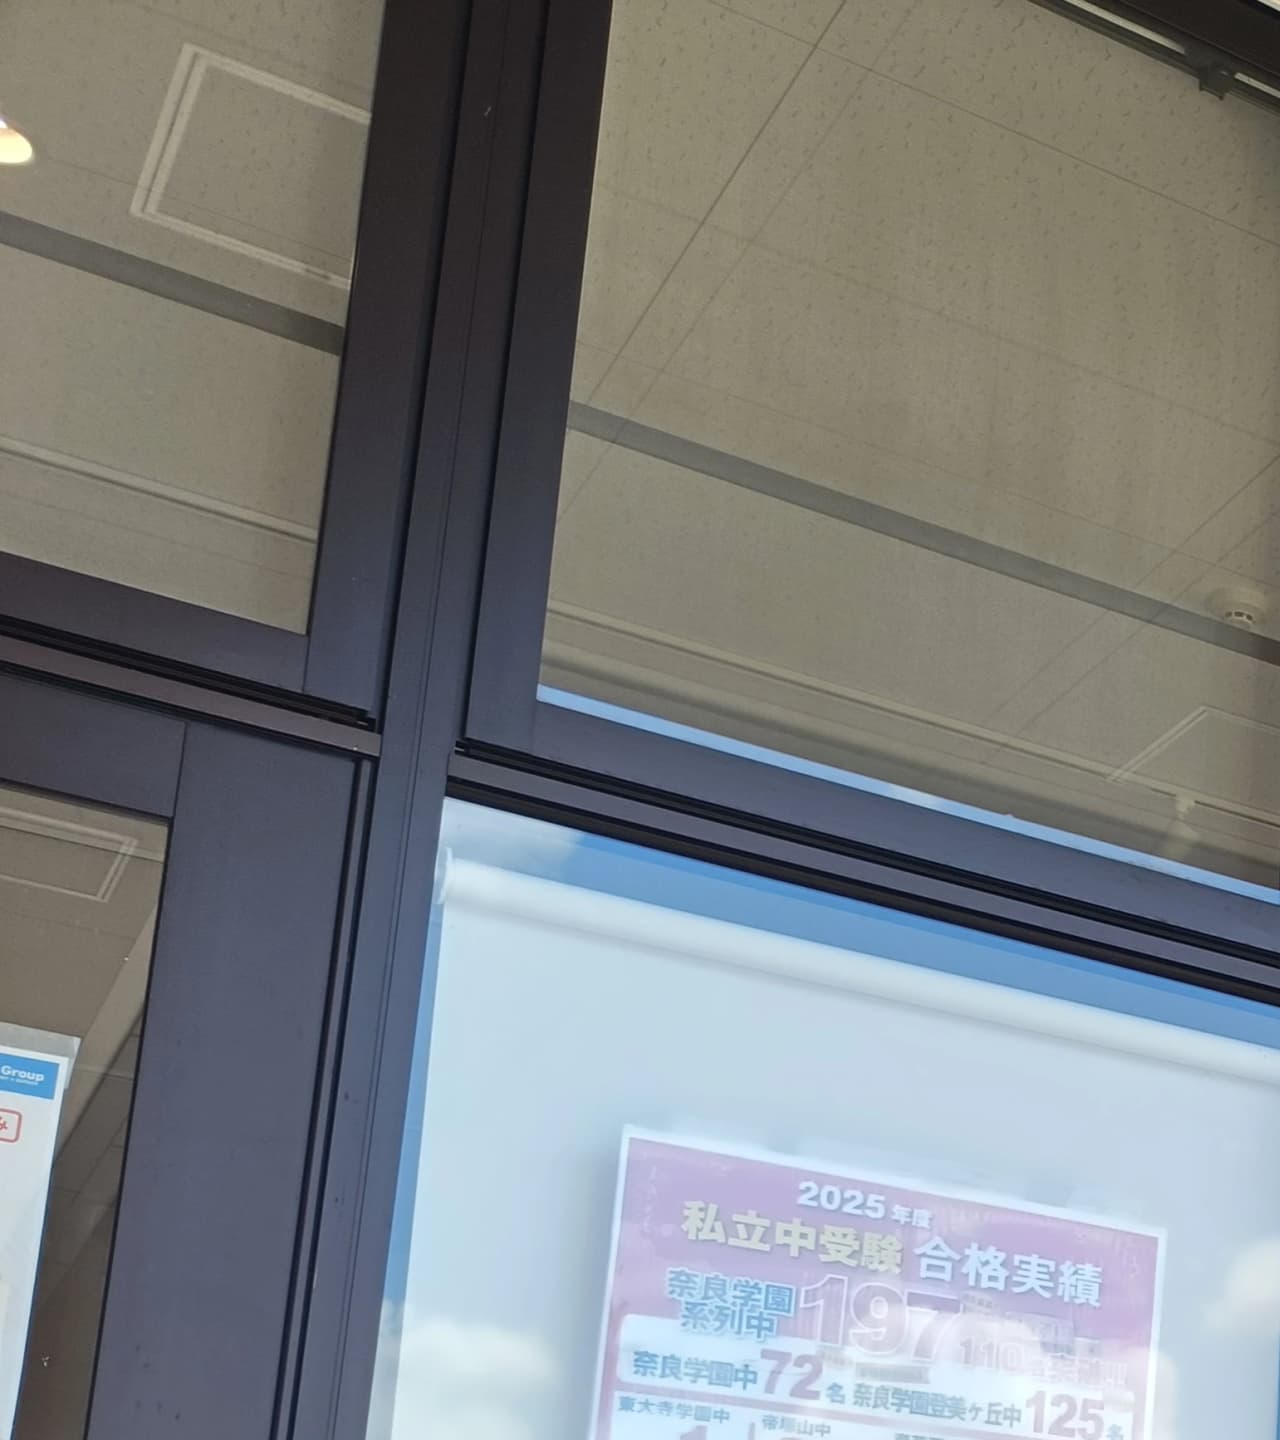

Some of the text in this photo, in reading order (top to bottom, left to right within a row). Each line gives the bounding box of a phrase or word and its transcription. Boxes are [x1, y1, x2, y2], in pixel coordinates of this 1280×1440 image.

[1, 1065, 45, 1083] Group
[681, 1200, 1102, 1307] 私立中受験 合格実績
[667, 1267, 795, 1316] 奈良学園
[680, 1302, 777, 1341] 系列中
